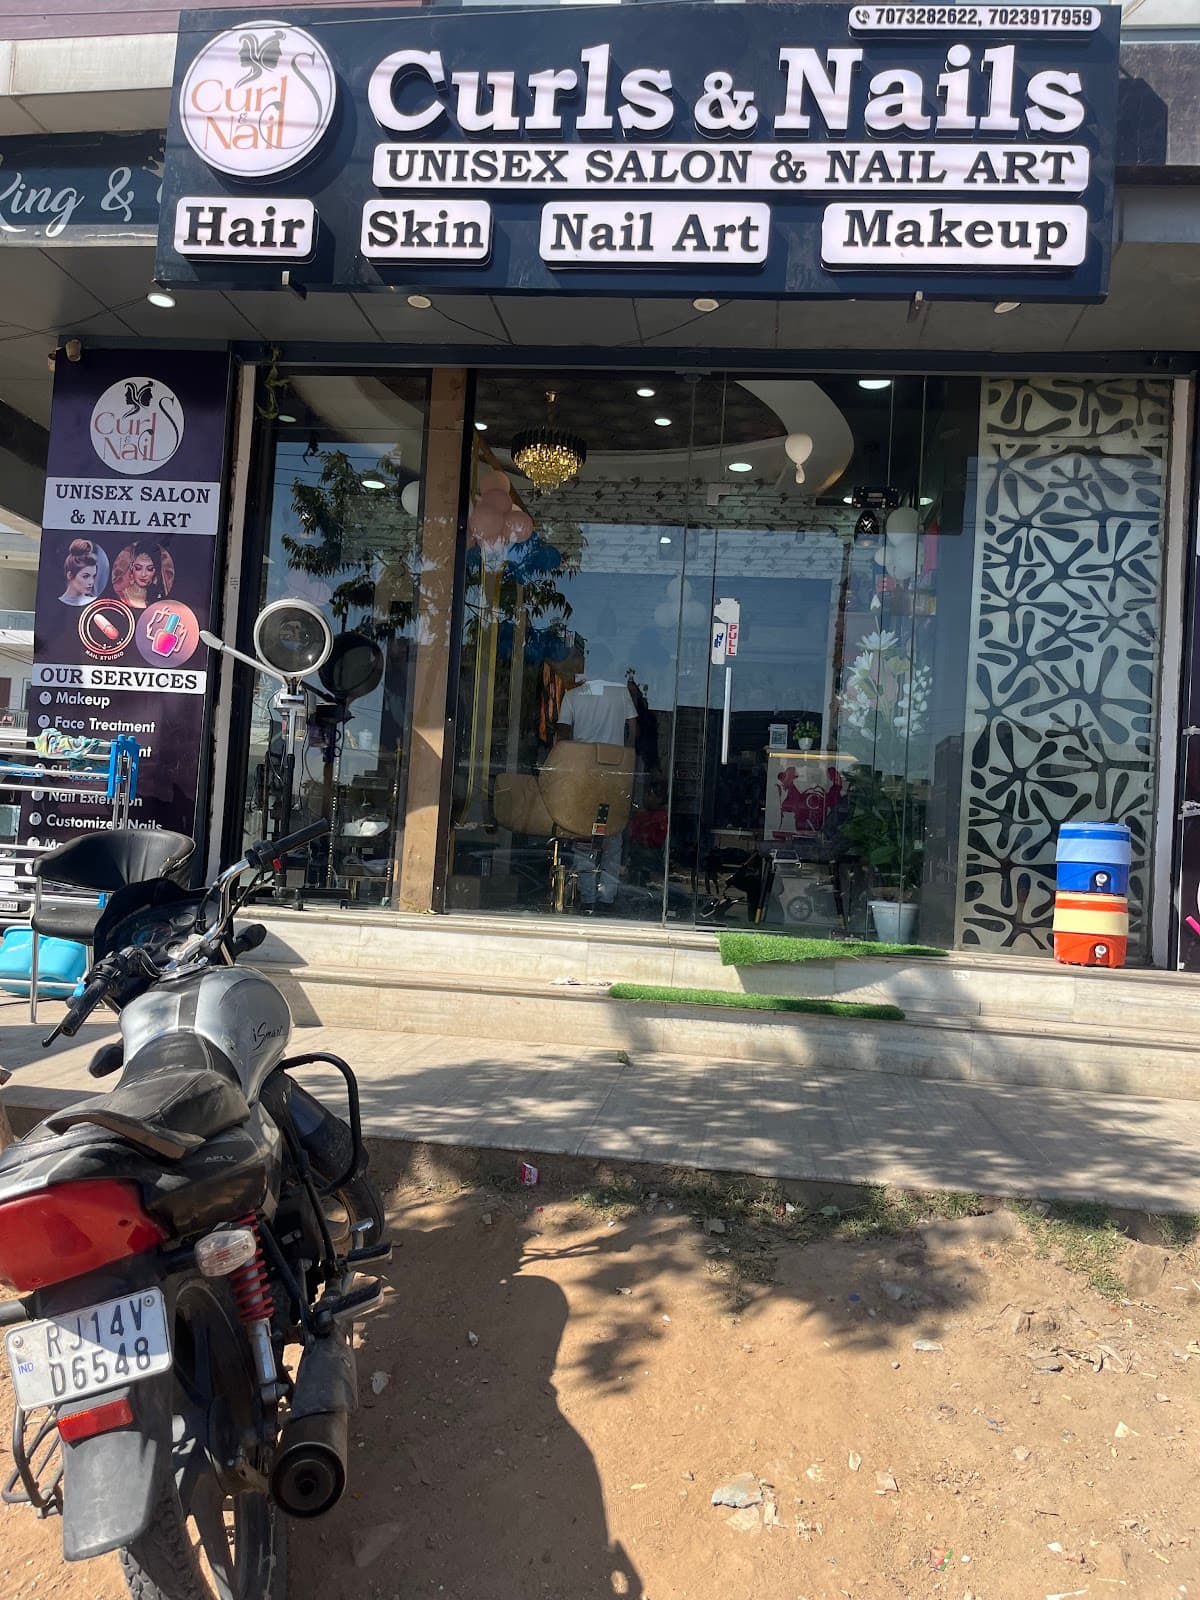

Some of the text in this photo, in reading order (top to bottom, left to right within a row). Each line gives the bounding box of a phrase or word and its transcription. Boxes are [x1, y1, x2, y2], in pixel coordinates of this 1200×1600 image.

[876, 9, 1092, 26] 7073282622, 7023917959
[368, 44, 1085, 133] Curls & Nails
[387, 150, 1075, 184] UNISEX SALON & NAIL ART
[100, 166, 135, 222] &
[183, 206, 305, 248] Hair
[367, 210, 485, 248] Skin
[550, 212, 760, 252] Nail Art
[842, 209, 1070, 260] Makeup
[55, 484, 211, 504] UNISEX SALON
[70, 509, 192, 528] & NAIL ART
[728, 625, 737, 655] PULL
[40, 668, 198, 690] OUR SERVICES
[55, 692, 111, 709] Makeup
[54, 716, 156, 733] Face Treatment
[17, 1362, 34, 1375] IND
